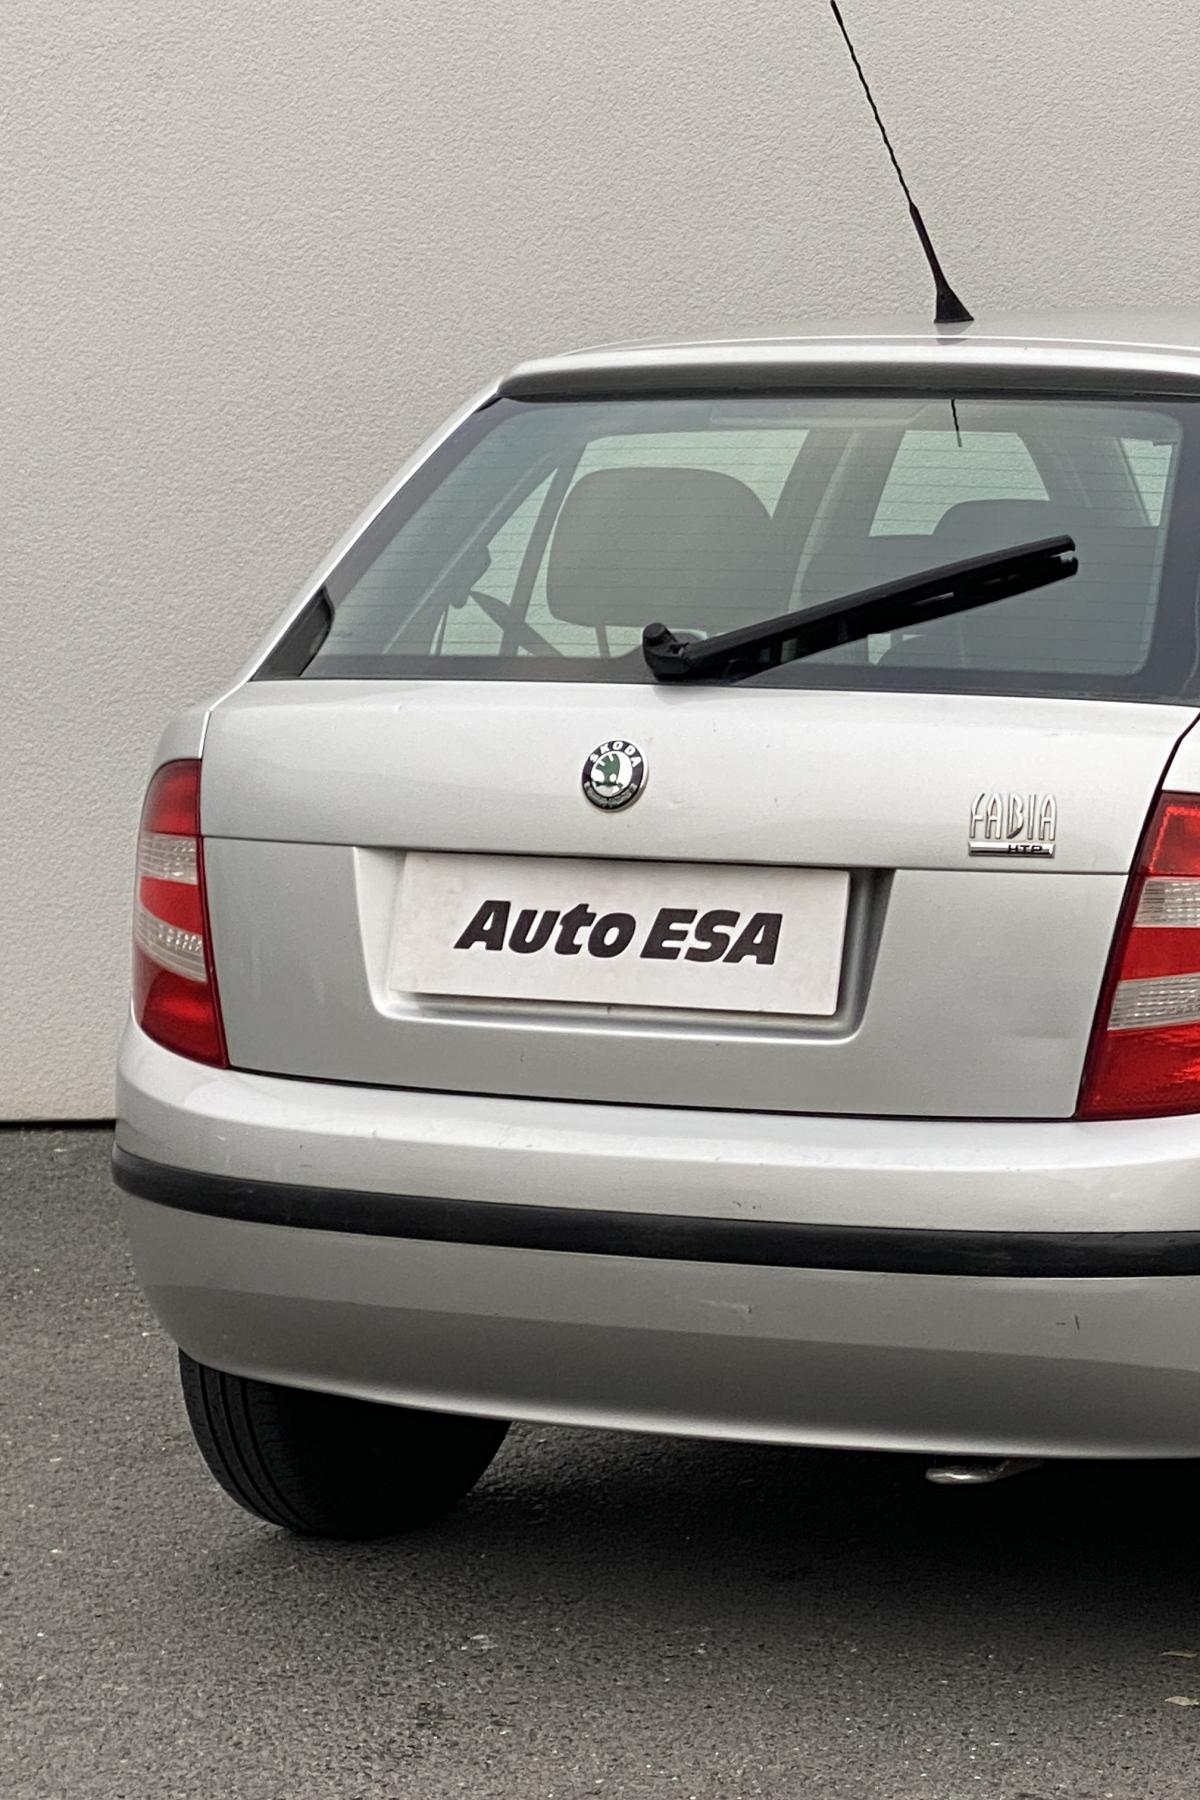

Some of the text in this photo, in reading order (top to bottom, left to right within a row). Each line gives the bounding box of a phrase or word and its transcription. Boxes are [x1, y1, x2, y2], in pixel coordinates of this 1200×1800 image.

[968, 791, 1058, 842] FABIA
[1008, 844, 1044, 855] HTP
[453, 899, 784, 966] Auto ESA
